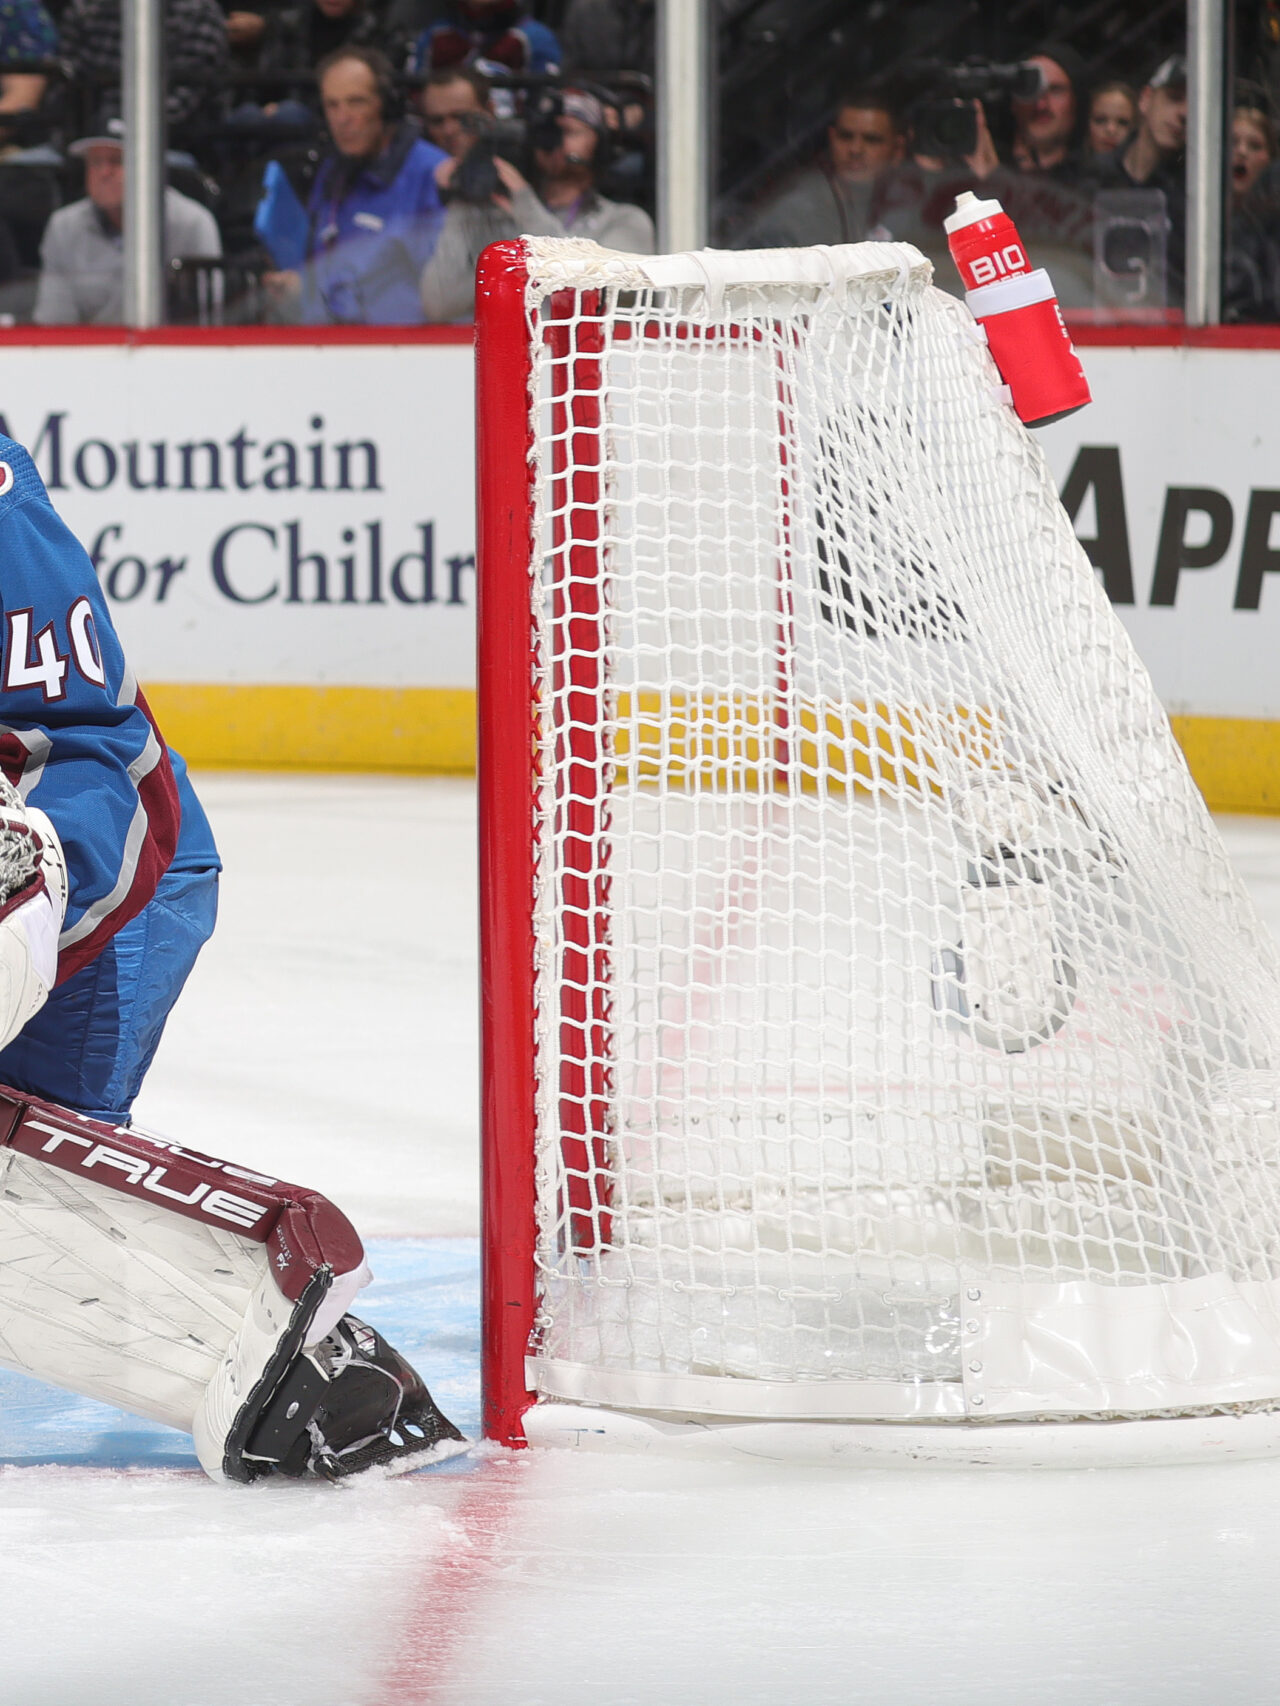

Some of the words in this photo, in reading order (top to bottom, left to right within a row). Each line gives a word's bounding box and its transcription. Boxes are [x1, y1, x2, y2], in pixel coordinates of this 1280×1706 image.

[969, 244, 1026, 284] BIO
[2, 595, 107, 704] 40
[23, 1120, 269, 1229] TRUE
